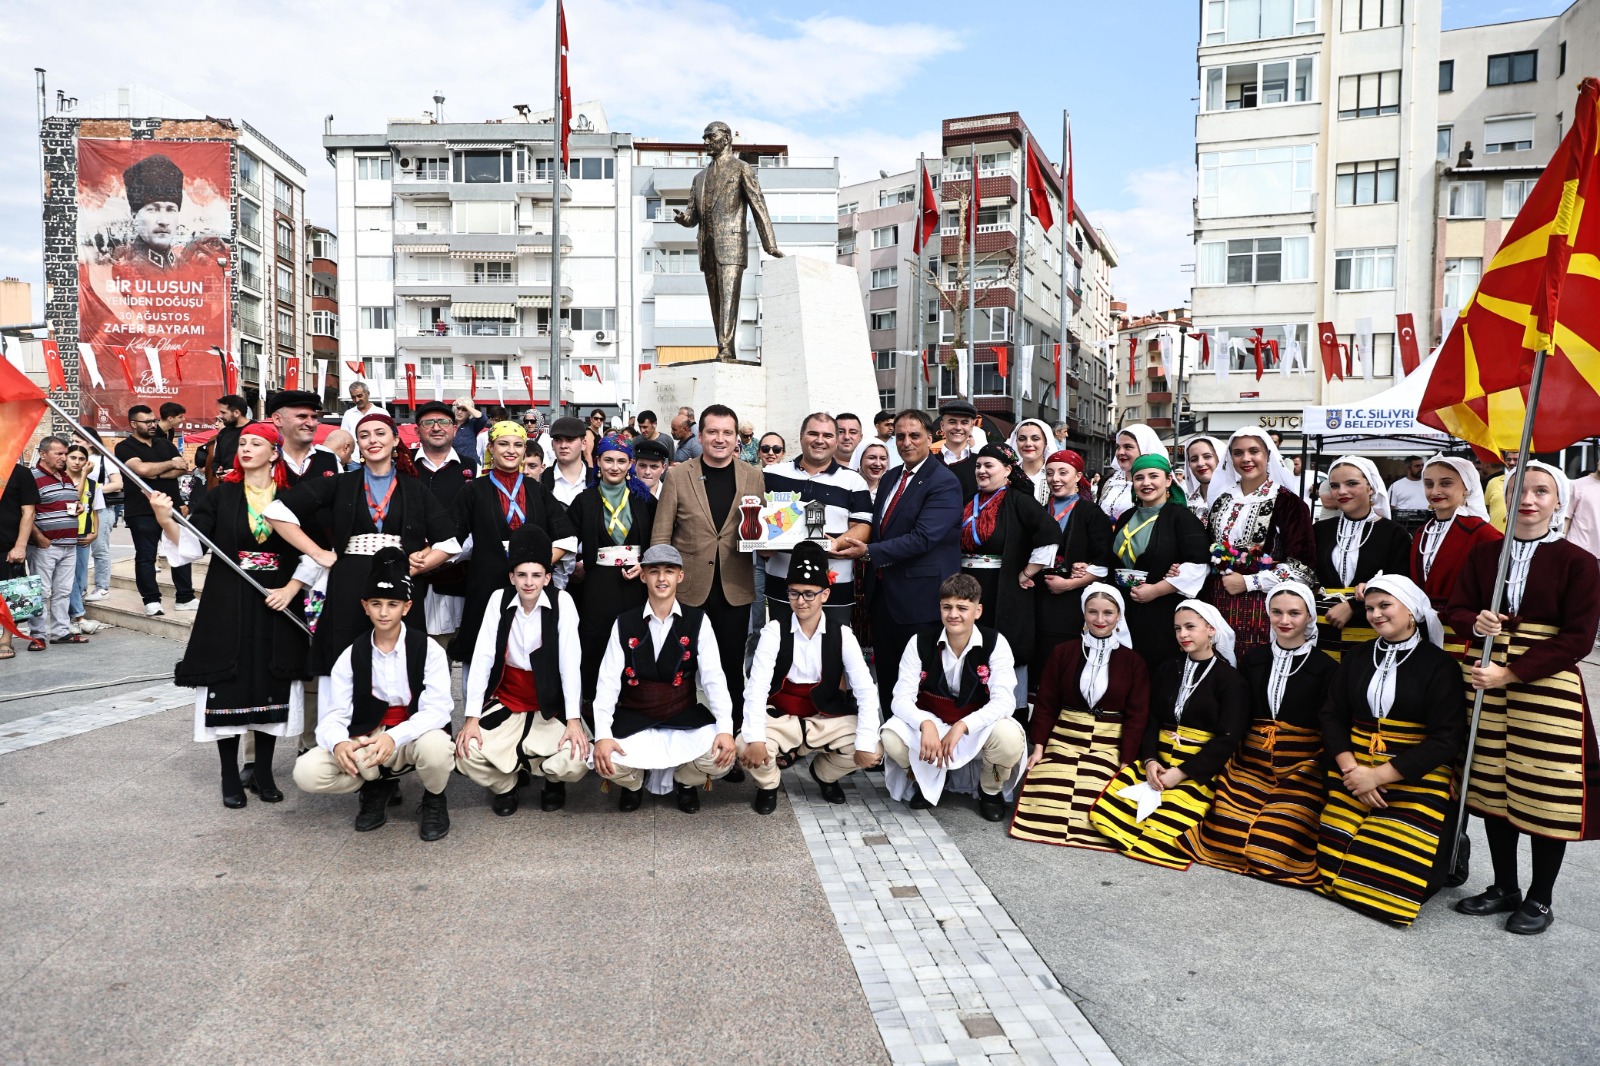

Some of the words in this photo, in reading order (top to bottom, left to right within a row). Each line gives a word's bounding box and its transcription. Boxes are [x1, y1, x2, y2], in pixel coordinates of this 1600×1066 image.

[106, 276, 131, 293] BİR
[135, 280, 203, 294] ULUSUN
[106, 295, 153, 307] YENİDEN
[156, 296, 204, 308] DOĞUŞU
[119, 312, 132, 320] 30
[136, 311, 190, 321] AĞUSTOS
[104, 323, 145, 334] ZAFER
[148, 325, 205, 335] BAYRAMI
[140, 369, 169, 386] Boa
[1345, 409, 1367, 419] T.C.
[1371, 409, 1414, 419] SİLİVRİ
[1344, 420, 1414, 429] BELEDİYESİ
